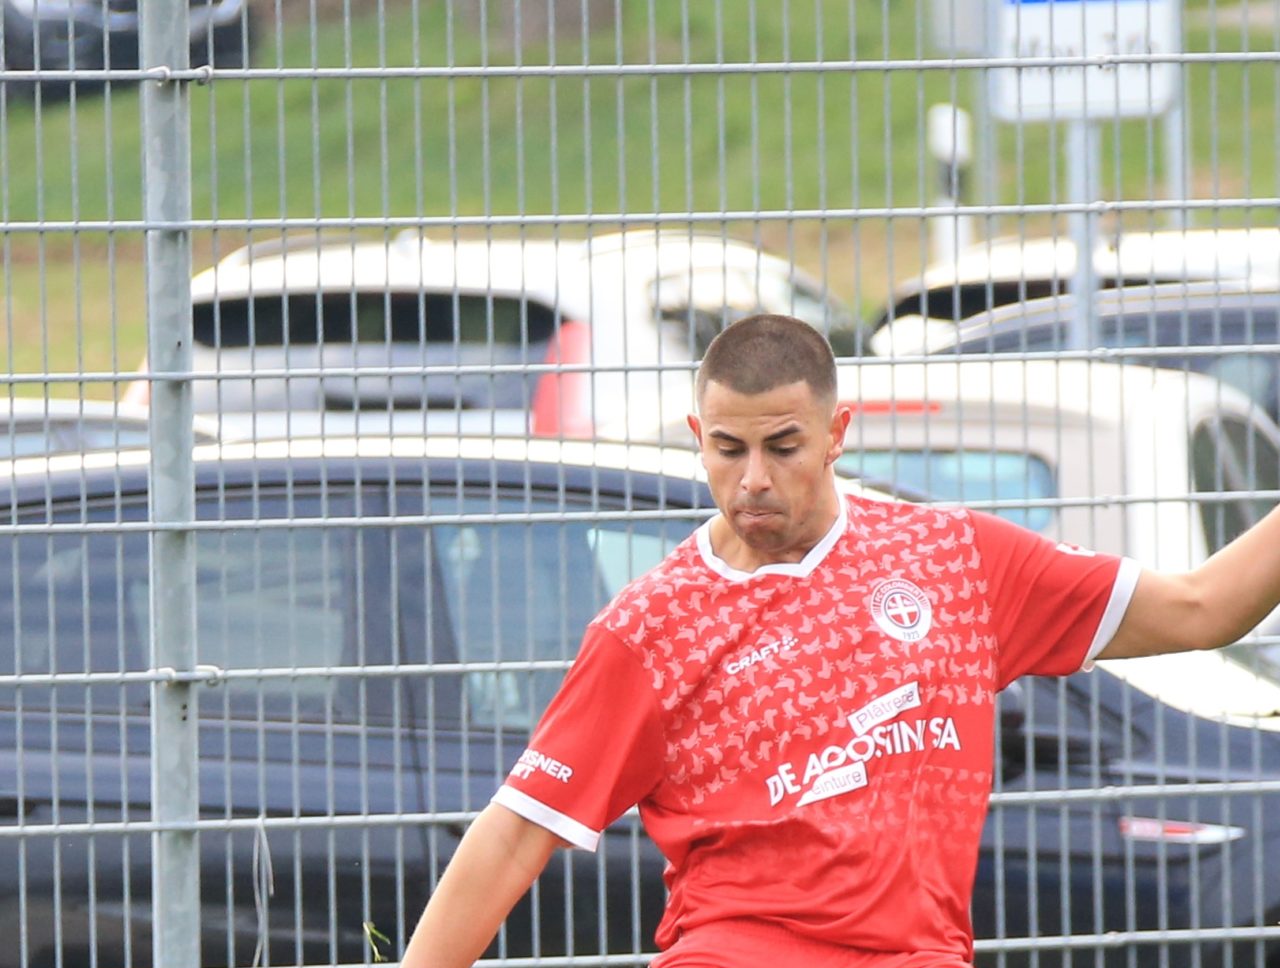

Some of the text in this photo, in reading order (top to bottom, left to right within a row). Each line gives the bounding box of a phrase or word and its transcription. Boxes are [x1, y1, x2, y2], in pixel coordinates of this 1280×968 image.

[726, 641, 781, 675] CRAFT
[765, 762, 801, 807] DE
[929, 717, 961, 750] SA
[811, 769, 862, 796] einture
